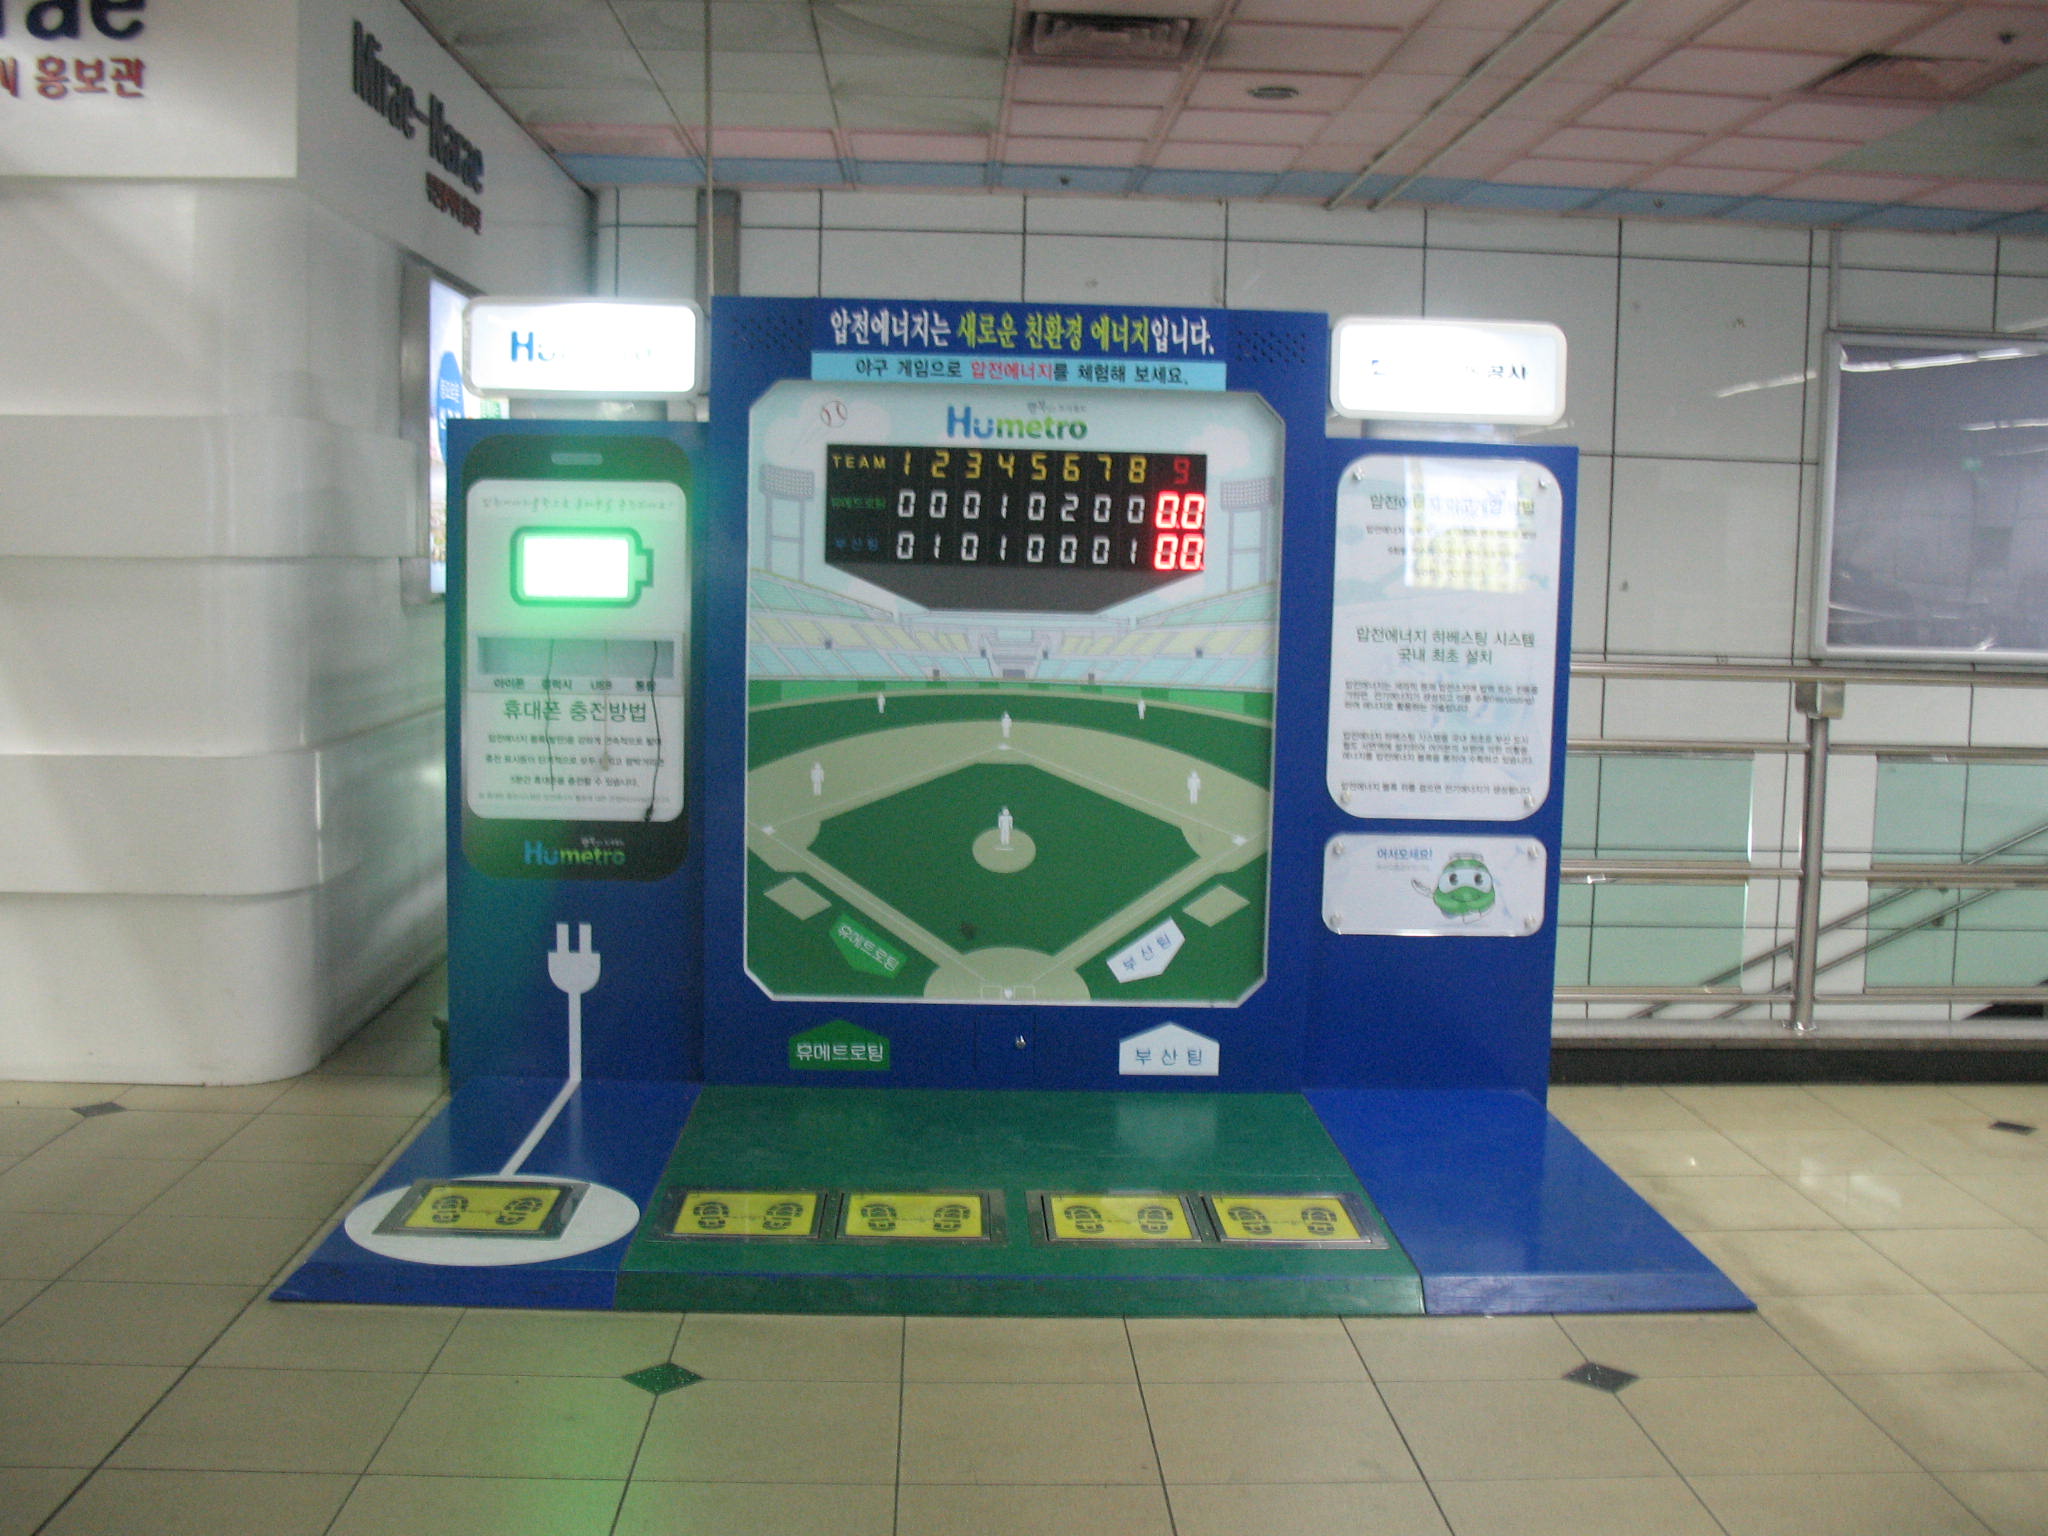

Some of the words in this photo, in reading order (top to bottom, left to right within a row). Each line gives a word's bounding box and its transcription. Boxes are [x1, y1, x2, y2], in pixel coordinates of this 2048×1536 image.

[830, 306, 951, 347] 압전에너지는
[957, 309, 1018, 349] 새로운
[1025, 311, 1083, 351] 친환경
[1090, 313, 1215, 355] 에너지입니다.
[856, 358, 888, 377] 야구
[897, 359, 962, 378] 게임으로
[971, 361, 1069, 382] 압전에너지를
[1078, 363, 1126, 383] 체험해
[1134, 366, 1189, 385] 보세요.
[947, 404, 1088, 439] Humetro
[832, 454, 887, 470] TEAM
[903, 449, 912, 476] 1
[931, 450, 950, 478] 2
[965, 450, 983, 479] 3
[998, 451, 1015, 479] 4
[1031, 452, 1048, 481] 5
[1062, 452, 1081, 482] 6
[1097, 453, 1113, 482] 7
[1128, 454, 1147, 483] 8
[1173, 456, 1191, 485] 9
[897, 488, 916, 518] 0
[929, 489, 948, 518] 0
[963, 490, 981, 519] 0
[1001, 492, 1009, 520] 1
[1027, 491, 1046, 521] 0
[1061, 492, 1080, 522] 2
[1093, 493, 1112, 523] 0
[1127, 494, 1146, 524] 0
[896, 530, 915, 560] 0
[933, 532, 942, 559] 1
[961, 531, 980, 561] 0
[999, 534, 1008, 561] 1
[1026, 534, 1045, 563] 0
[1059, 534, 1078, 564] 0
[1091, 535, 1110, 565] 0
[1130, 537, 1138, 565] 1
[1357, 625, 1427, 644] 압전에너지
[1432, 628, 1488, 646] 하베스팅
[1494, 631, 1536, 648] 시스템
[1399, 649, 1426, 663] 국내
[1432, 649, 1460, 663] 최초
[1466, 650, 1494, 665] 설치
[504, 700, 562, 721] 휴대폰
[570, 700, 646, 722] 충전방법
[524, 839, 626, 866] Humetro
